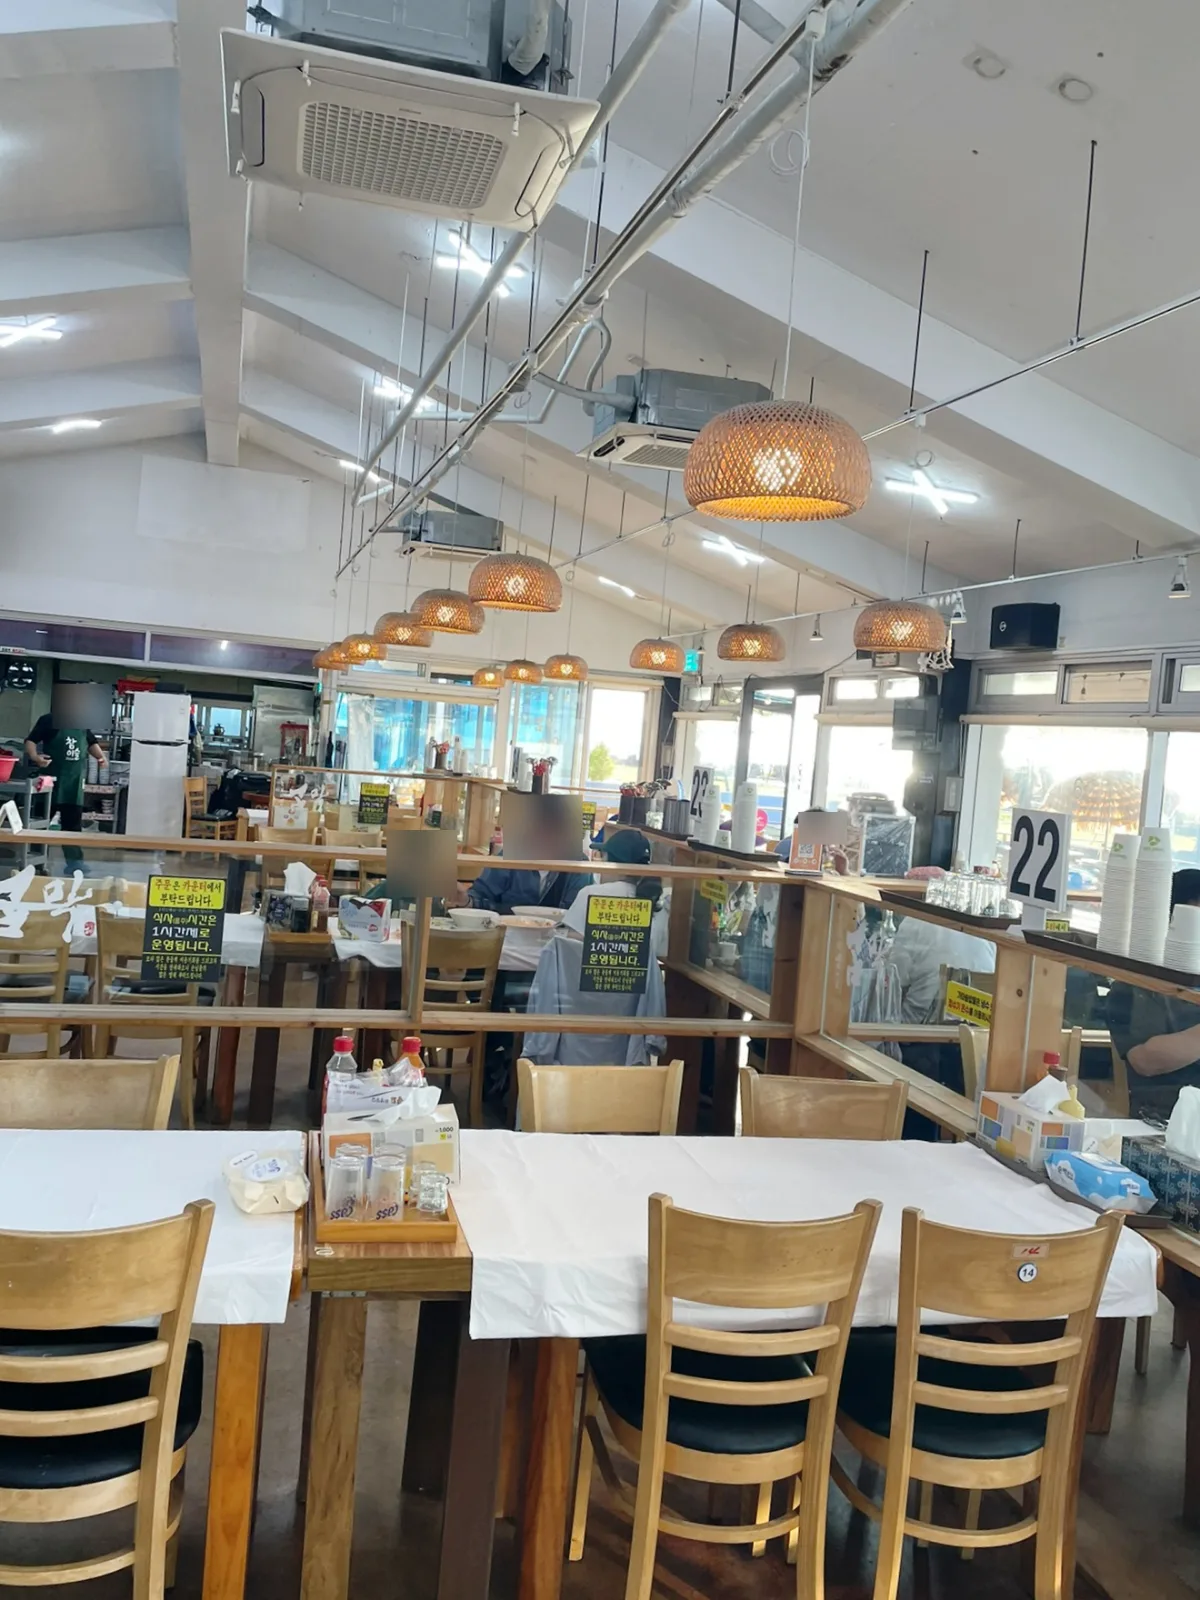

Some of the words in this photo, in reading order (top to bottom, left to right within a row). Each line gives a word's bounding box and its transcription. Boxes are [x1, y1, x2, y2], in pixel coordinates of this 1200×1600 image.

[1009, 814, 1060, 903] 22
[155, 879, 181, 891] 주문은
[182, 880, 222, 893] 카운터에서
[160, 893, 214, 907] 부탁드립니다.
[616, 899, 650, 912] 카운터에서
[597, 912, 643, 925] 부탁드립니다.
[151, 939, 212, 952] 운영됩니다.
[589, 954, 641, 966] 운영됩니다.
[330, 1206, 353, 1220] Cass
[375, 1203, 399, 1220] Cass
[1022, 1268, 1034, 1277] 14
